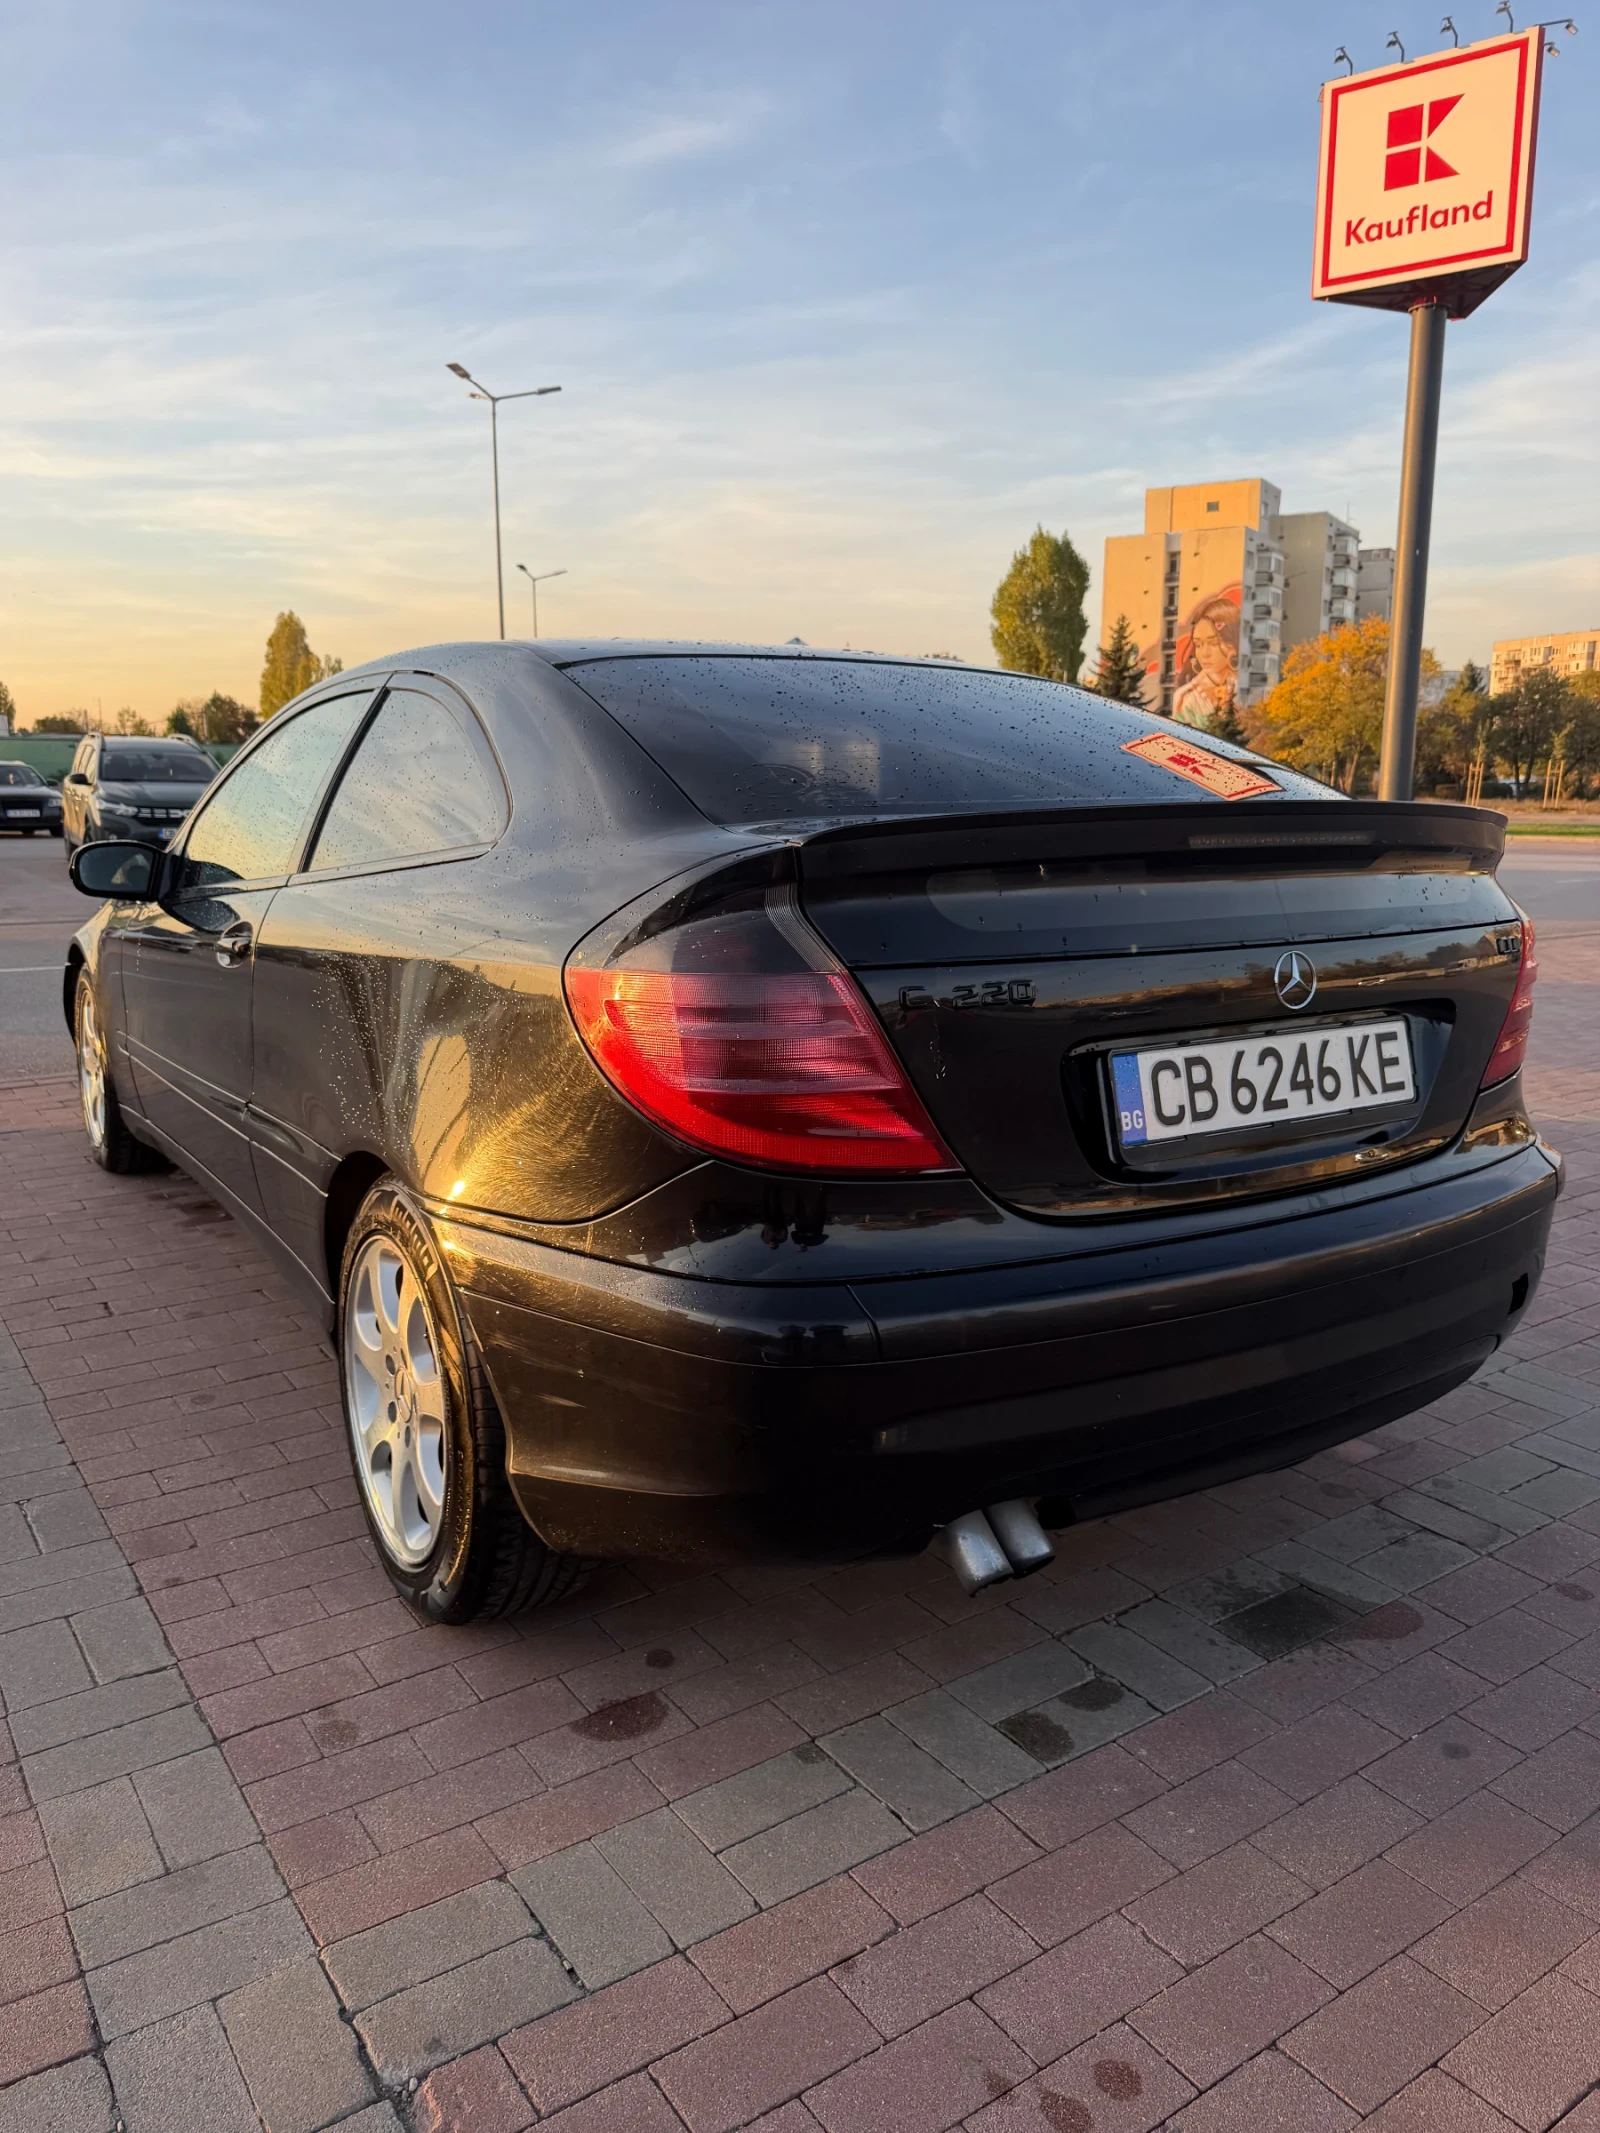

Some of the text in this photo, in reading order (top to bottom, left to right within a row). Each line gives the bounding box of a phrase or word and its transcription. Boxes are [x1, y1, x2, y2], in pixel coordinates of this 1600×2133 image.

[1345, 190, 1493, 247] Kaufland
[899, 980, 1036, 1010] C 220
[1150, 1031, 1405, 1126] CB 6246 KE
[1120, 1111, 1143, 1132] BG
